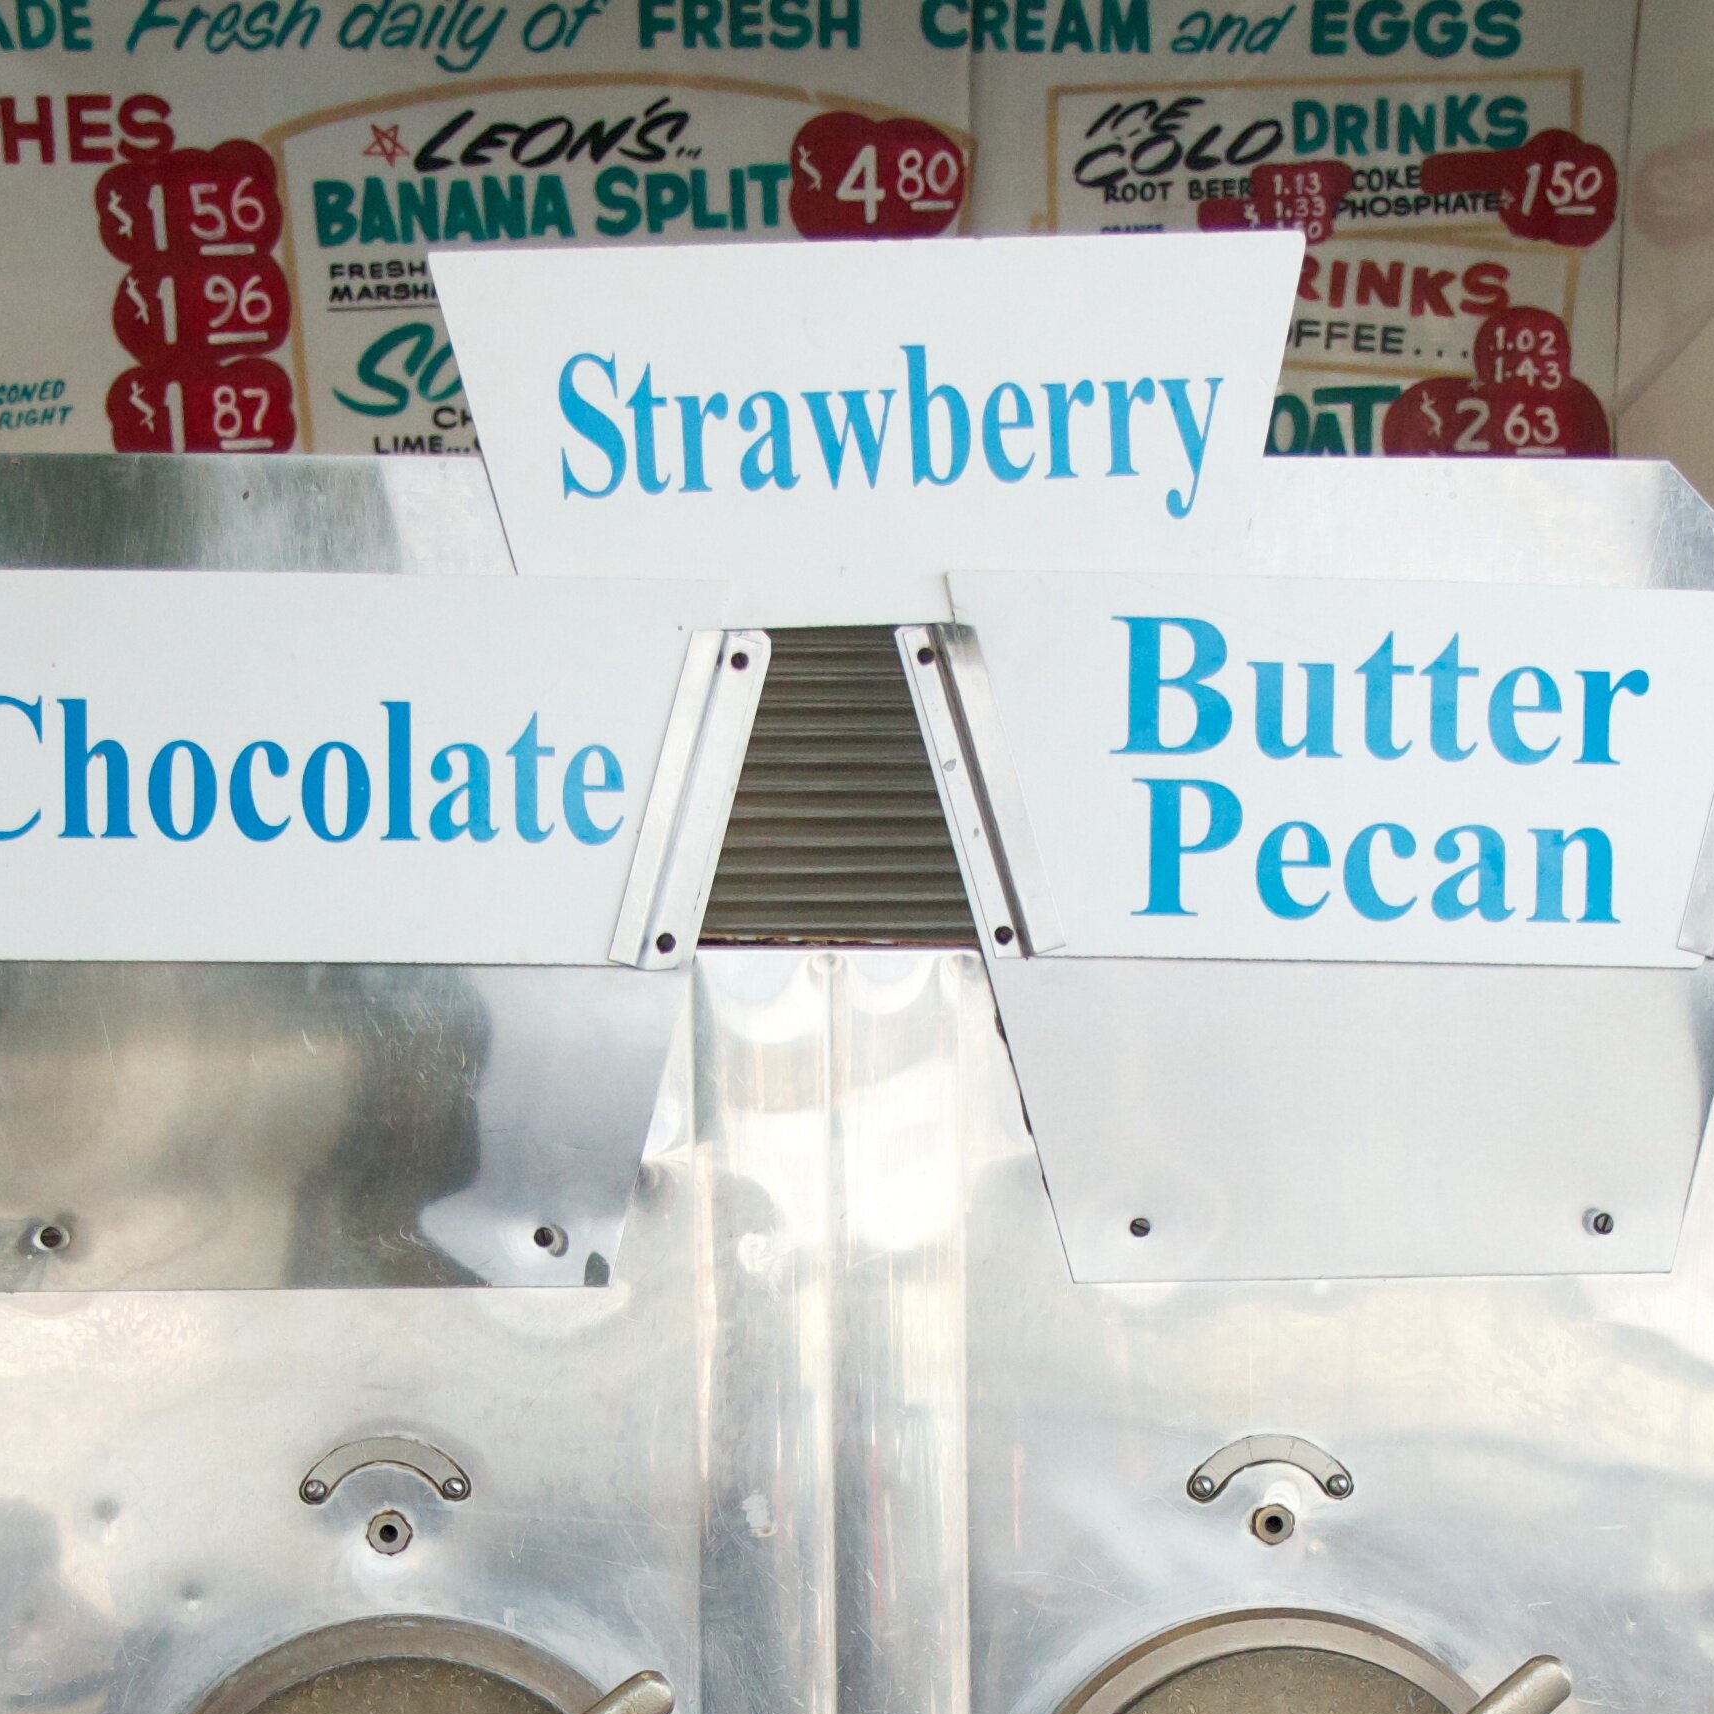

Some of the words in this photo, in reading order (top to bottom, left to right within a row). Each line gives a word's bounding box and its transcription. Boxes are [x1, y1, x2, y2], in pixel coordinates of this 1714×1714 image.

[126, 0, 313, 54] Fresh
[338, 0, 497, 72] daily
[522, 0, 603, 51] of
[638, 0, 861, 50] FRESH
[921, 0, 1150, 54] CREAM
[1170, 0, 1290, 55] and
[1311, 0, 1522, 58] EGGS
[1073, 117, 1285, 188] COLD
[1292, 93, 1531, 158] DRINKS
[1086, 96, 1203, 140] ICE
[312, 174, 576, 247] BANANA
[594, 163, 789, 237] SPLIT
[1104, 181, 1175, 204] ROOT
[1187, 177, 1253, 201] BEER
[1333, 191, 1502, 218] PHOSPHATE
[1350, 165, 1422, 193] COKE
[329, 260, 427, 281] FRESH
[557, 344, 1225, 519] Strawberry
[1109, 614, 1649, 766] Butter
[1129, 776, 1621, 925] Pecan
